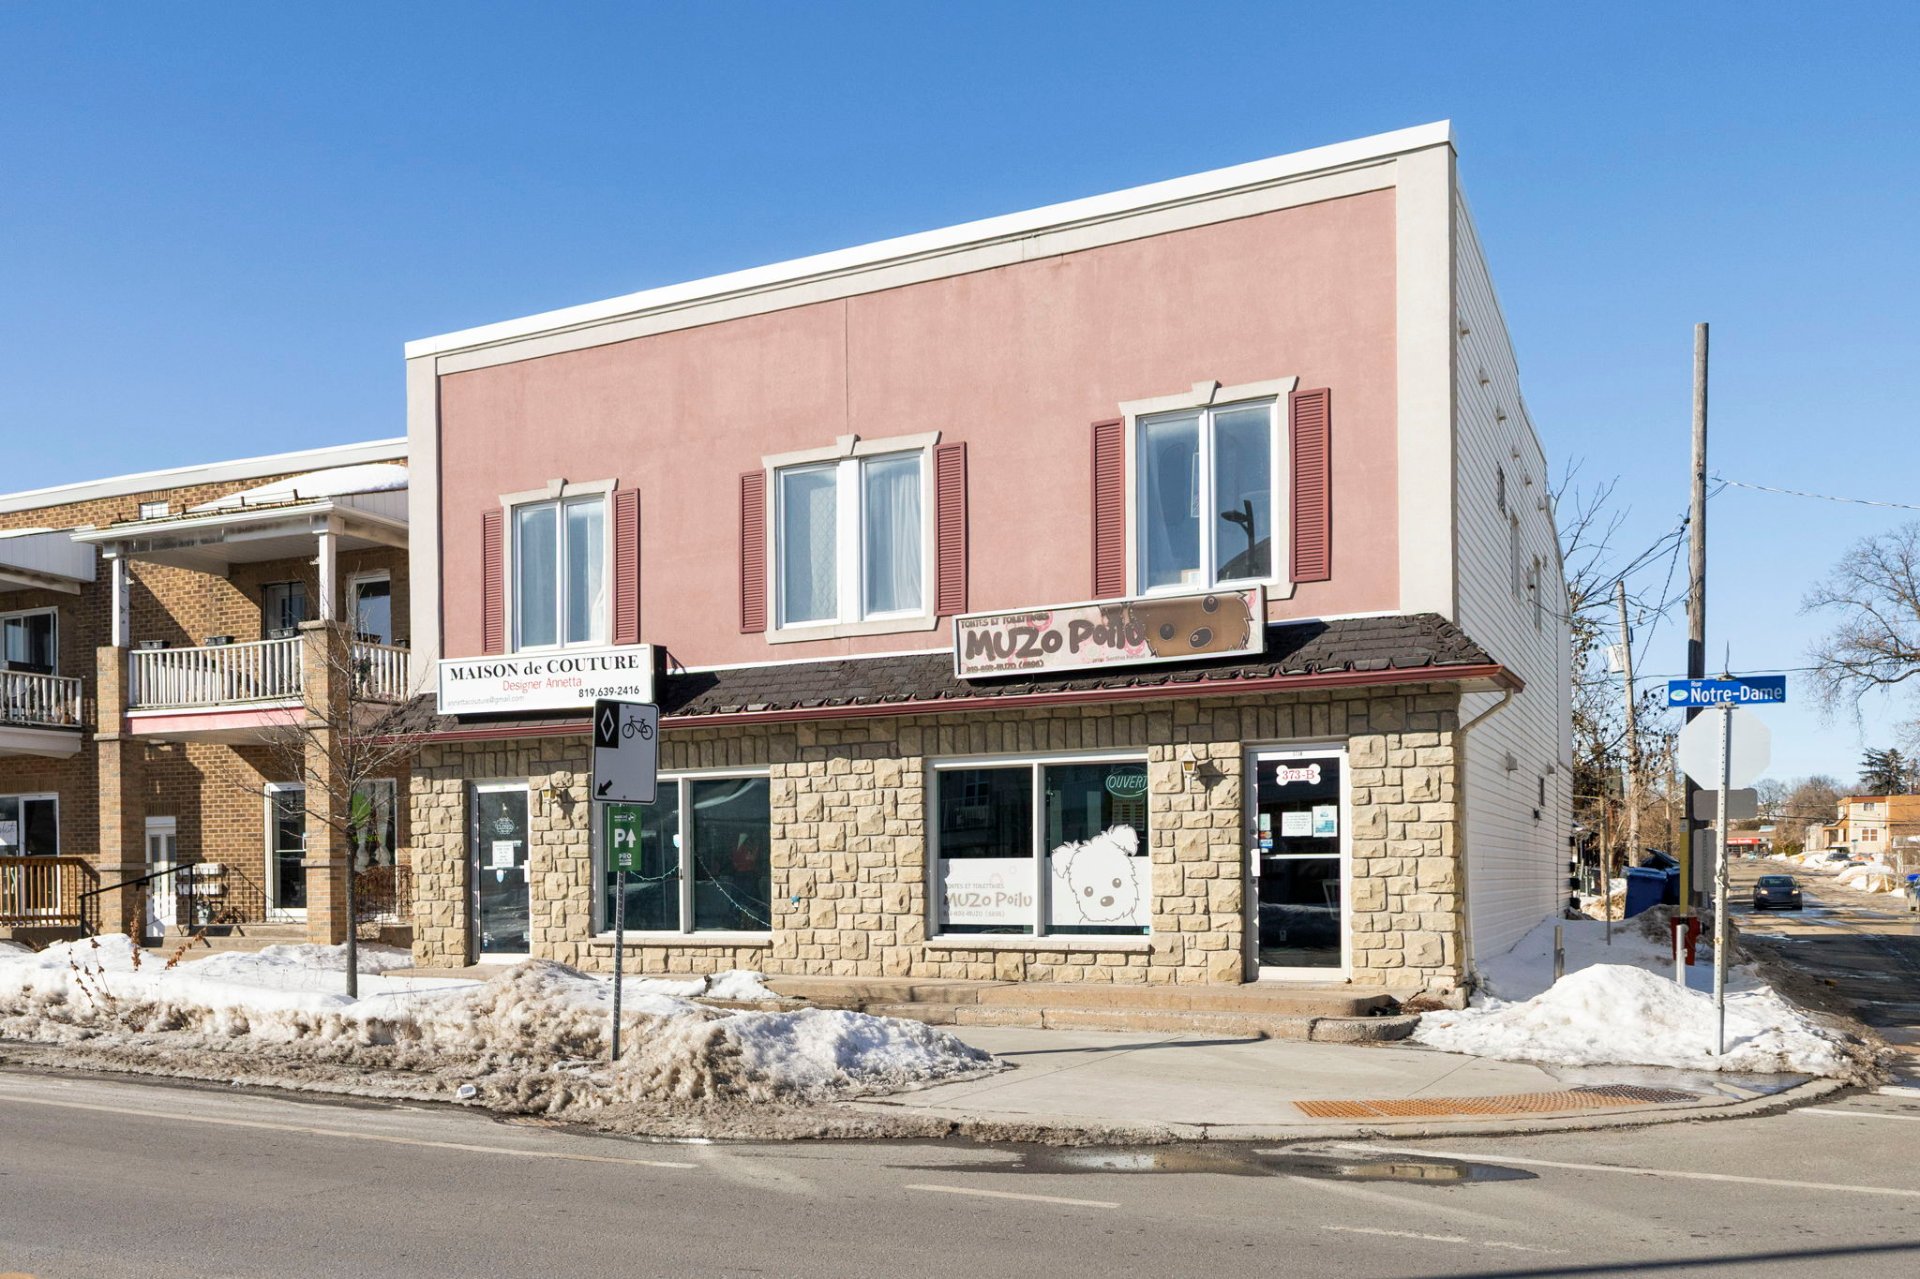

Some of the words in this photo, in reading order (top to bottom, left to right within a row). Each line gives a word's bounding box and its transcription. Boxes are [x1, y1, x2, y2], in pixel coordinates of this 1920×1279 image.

[450, 662, 519, 681] MAISON
[523, 661, 542, 676] de
[546, 655, 639, 674] COUTURE
[502, 679, 542, 694] Designer
[546, 677, 582, 689] Annetta
[1690, 680, 1703, 688] Rue
[1690, 686, 1782, 703] Notre-Dame
[1108, 775, 1148, 789] OUVERT
[1282, 769, 1315, 780] 373-B
[614, 828, 626, 848] P
[995, 891, 1033, 908] Poilu
